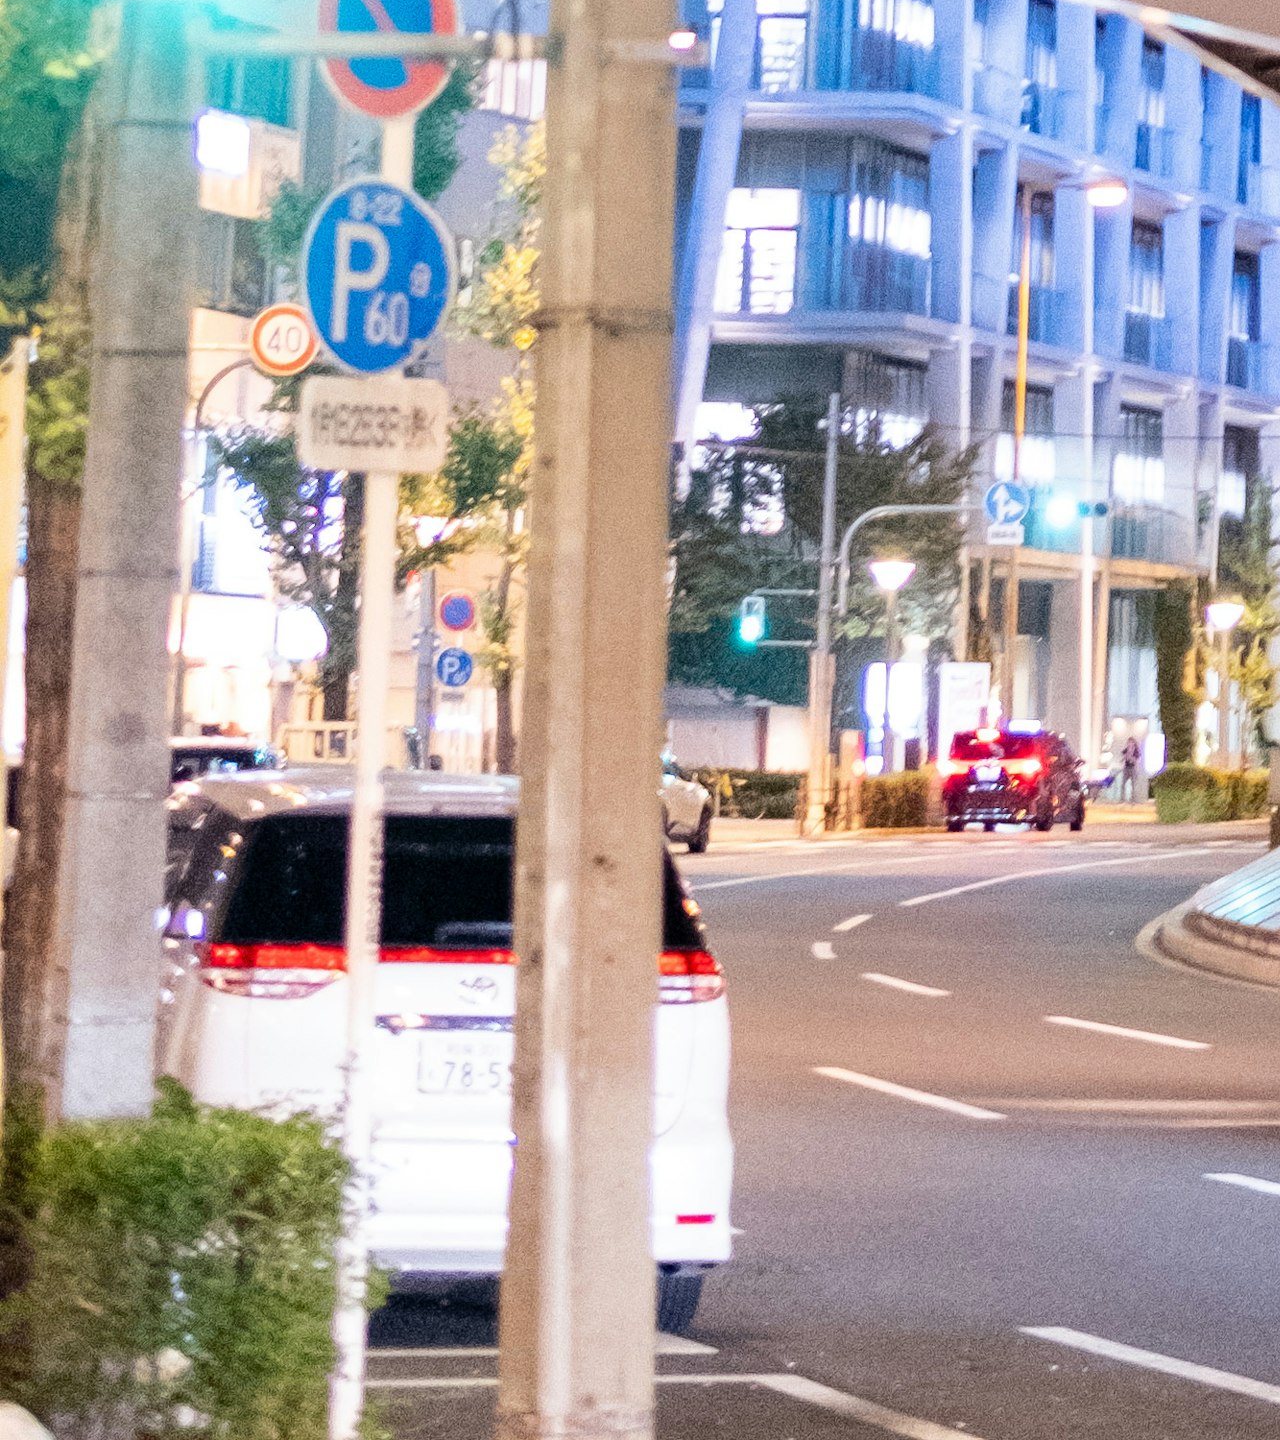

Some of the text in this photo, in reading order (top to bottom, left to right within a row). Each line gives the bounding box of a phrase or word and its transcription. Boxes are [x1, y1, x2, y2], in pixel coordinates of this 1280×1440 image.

[330, 220, 391, 343] P
[267, 326, 303, 354] 40
[364, 291, 410, 348] 60
